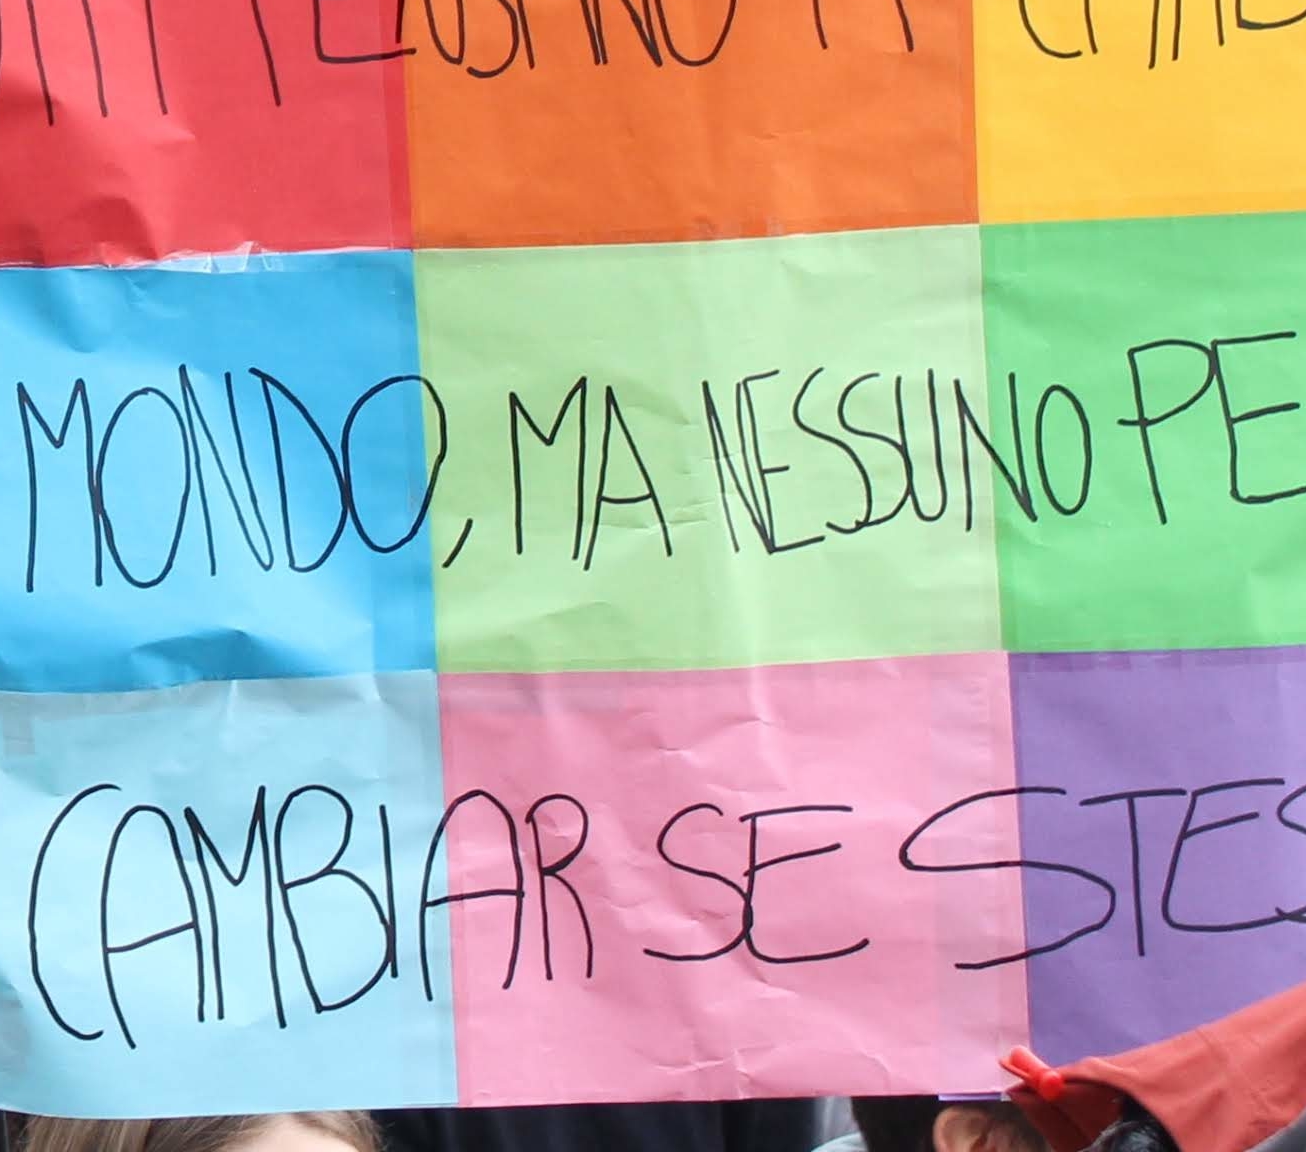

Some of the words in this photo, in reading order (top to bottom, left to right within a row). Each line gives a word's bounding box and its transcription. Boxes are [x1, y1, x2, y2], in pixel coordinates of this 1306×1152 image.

[17, 363, 475, 594] MONDO,
[509, 375, 674, 571] MA
[701, 366, 1094, 555] NESSUNO
[29, 782, 593, 1049] CAMBIAR
[643, 802, 869, 964] SE
